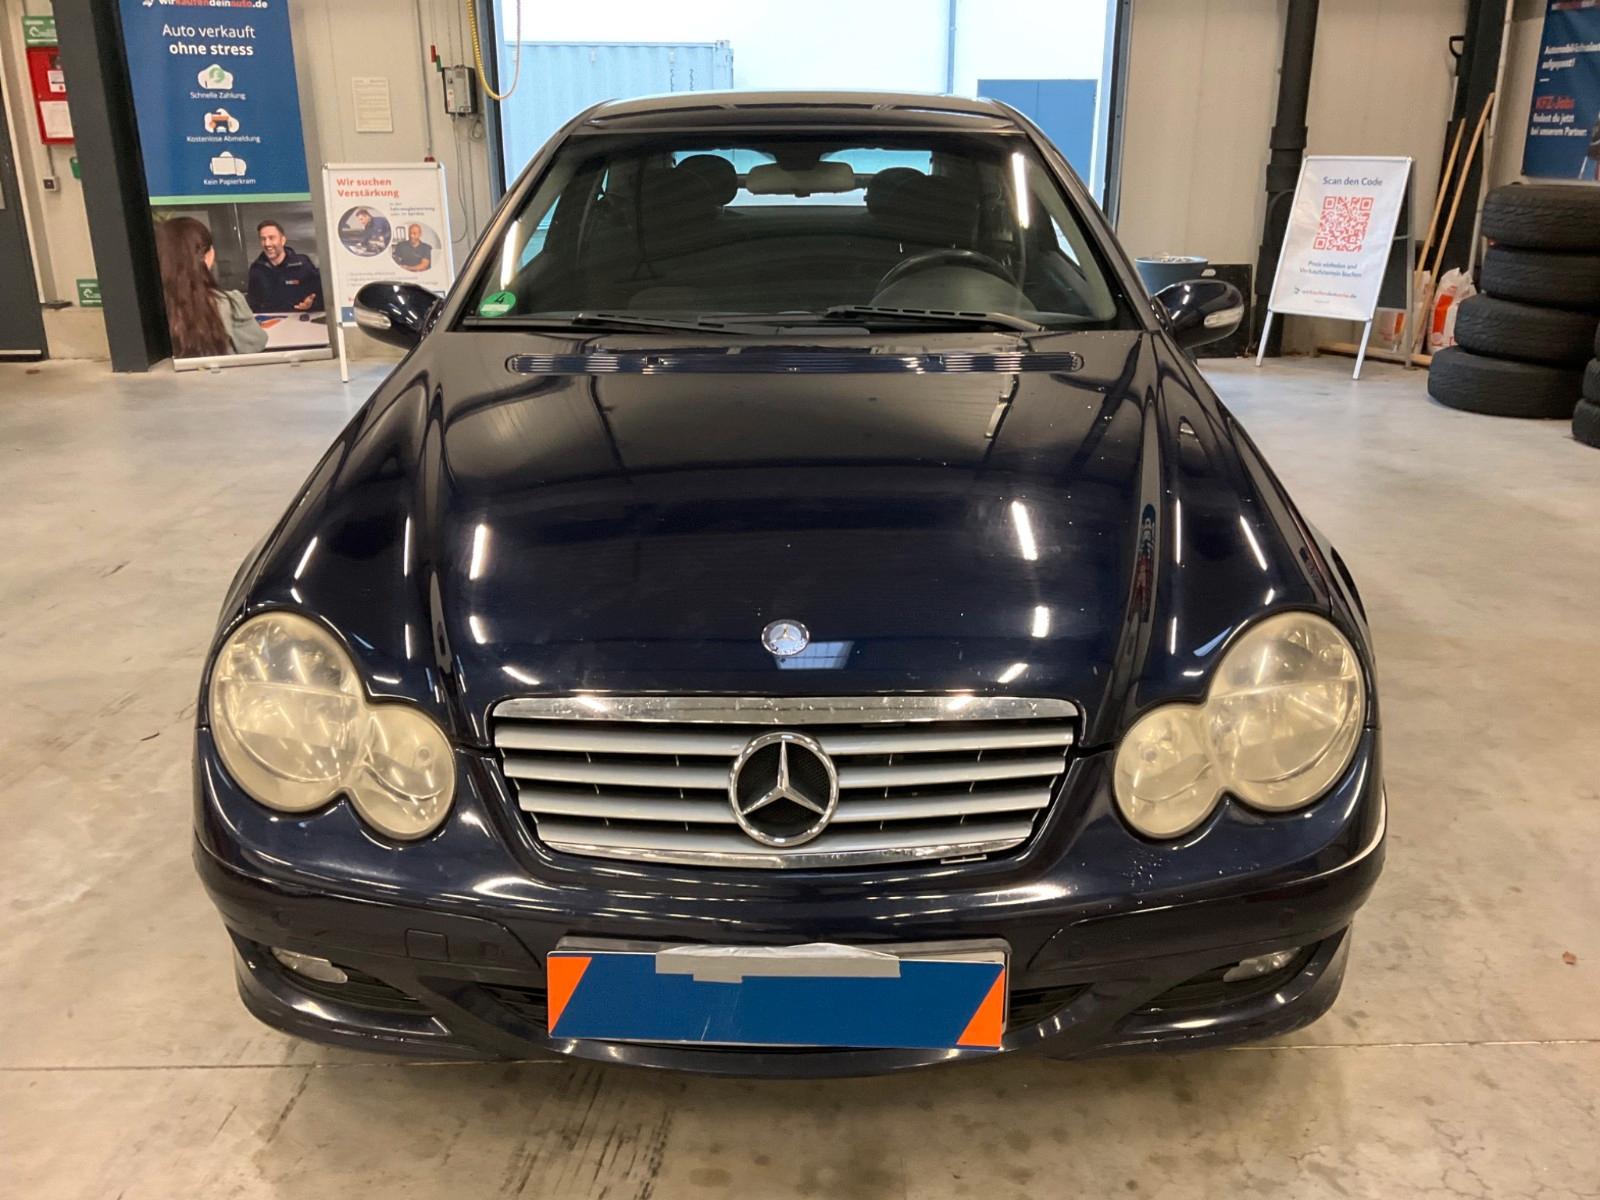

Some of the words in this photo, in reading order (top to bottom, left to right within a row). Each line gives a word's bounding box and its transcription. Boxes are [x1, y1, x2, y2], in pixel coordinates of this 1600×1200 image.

[162, 24, 195, 37] Auto
[199, 25, 256, 39] verkauft
[169, 41, 206, 55] ohne
[210, 44, 254, 56] stress
[190, 91, 217, 99] Schnelle
[219, 92, 246, 100] Zahlung
[223, 135, 261, 143] Abmeldung
[336, 178, 354, 186] Wir
[356, 178, 392, 186] suchen
[1322, 176, 1342, 186] Scan
[1343, 176, 1360, 186] den
[1361, 177, 1383, 187] Code
[337, 188, 400, 198] Verstärkung
[494, 292, 506, 304] 4
